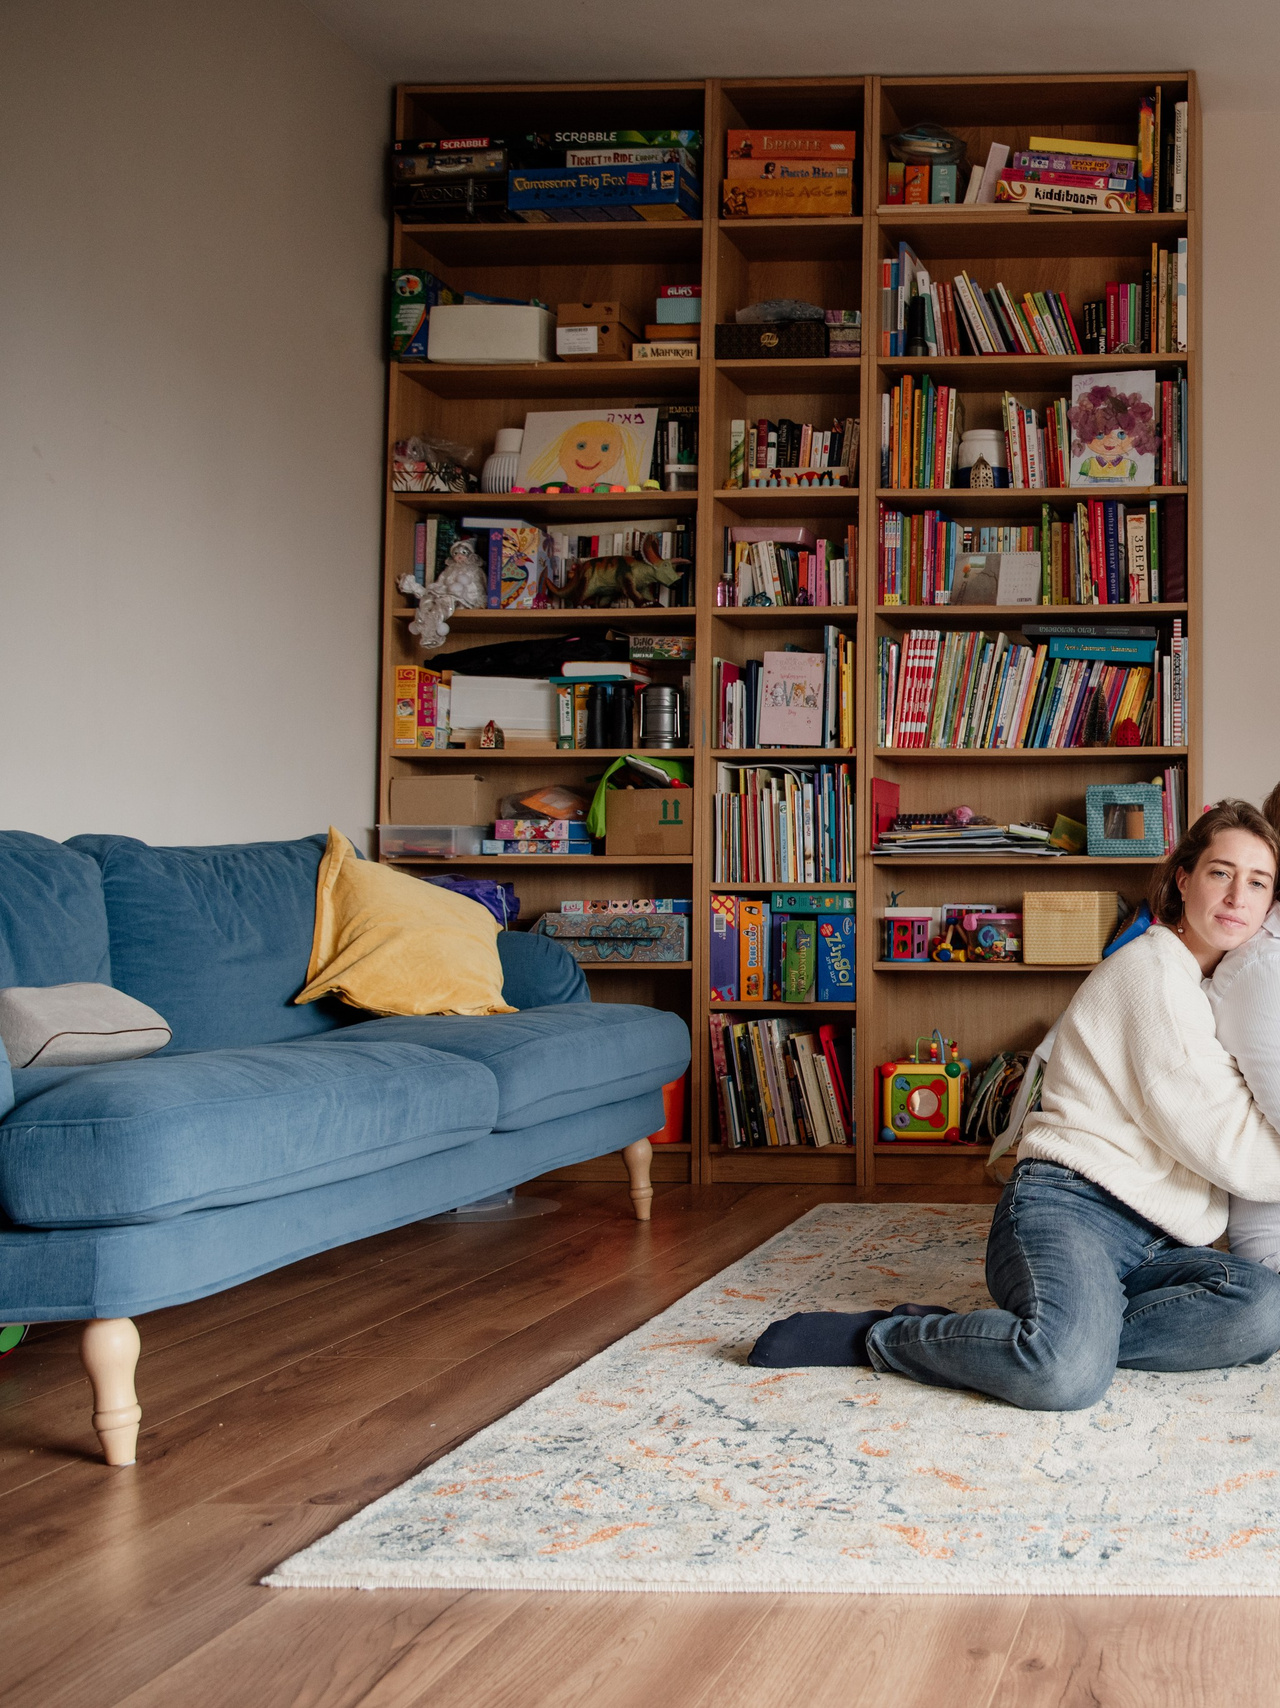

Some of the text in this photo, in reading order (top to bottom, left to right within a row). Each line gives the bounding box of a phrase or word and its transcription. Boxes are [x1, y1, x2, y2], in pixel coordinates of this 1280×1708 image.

[554, 131, 617, 144] SCRABBLE
[442, 139, 489, 149] SCRABBLE
[570, 154, 602, 165] TICKET
[613, 152, 634, 164] RIDE
[779, 165, 834, 178] Puerto Rico
[512, 176, 578, 192] Carcassonne
[578, 174, 600, 191] Big
[600, 173, 627, 187] Box
[1094, 177, 1105, 189] 4
[745, 187, 795, 200] STONE
[798, 185, 834, 199] AGE
[650, 347, 693, 358] Манчкин
[606, 412, 646, 425] מאיה
[1038, 626, 1076, 634] человека
[1077, 627, 1097, 635] Тело
[399, 669, 415, 680] IQ
[420, 672, 432, 684] IQ
[825, 931, 853, 988] Zingo!
